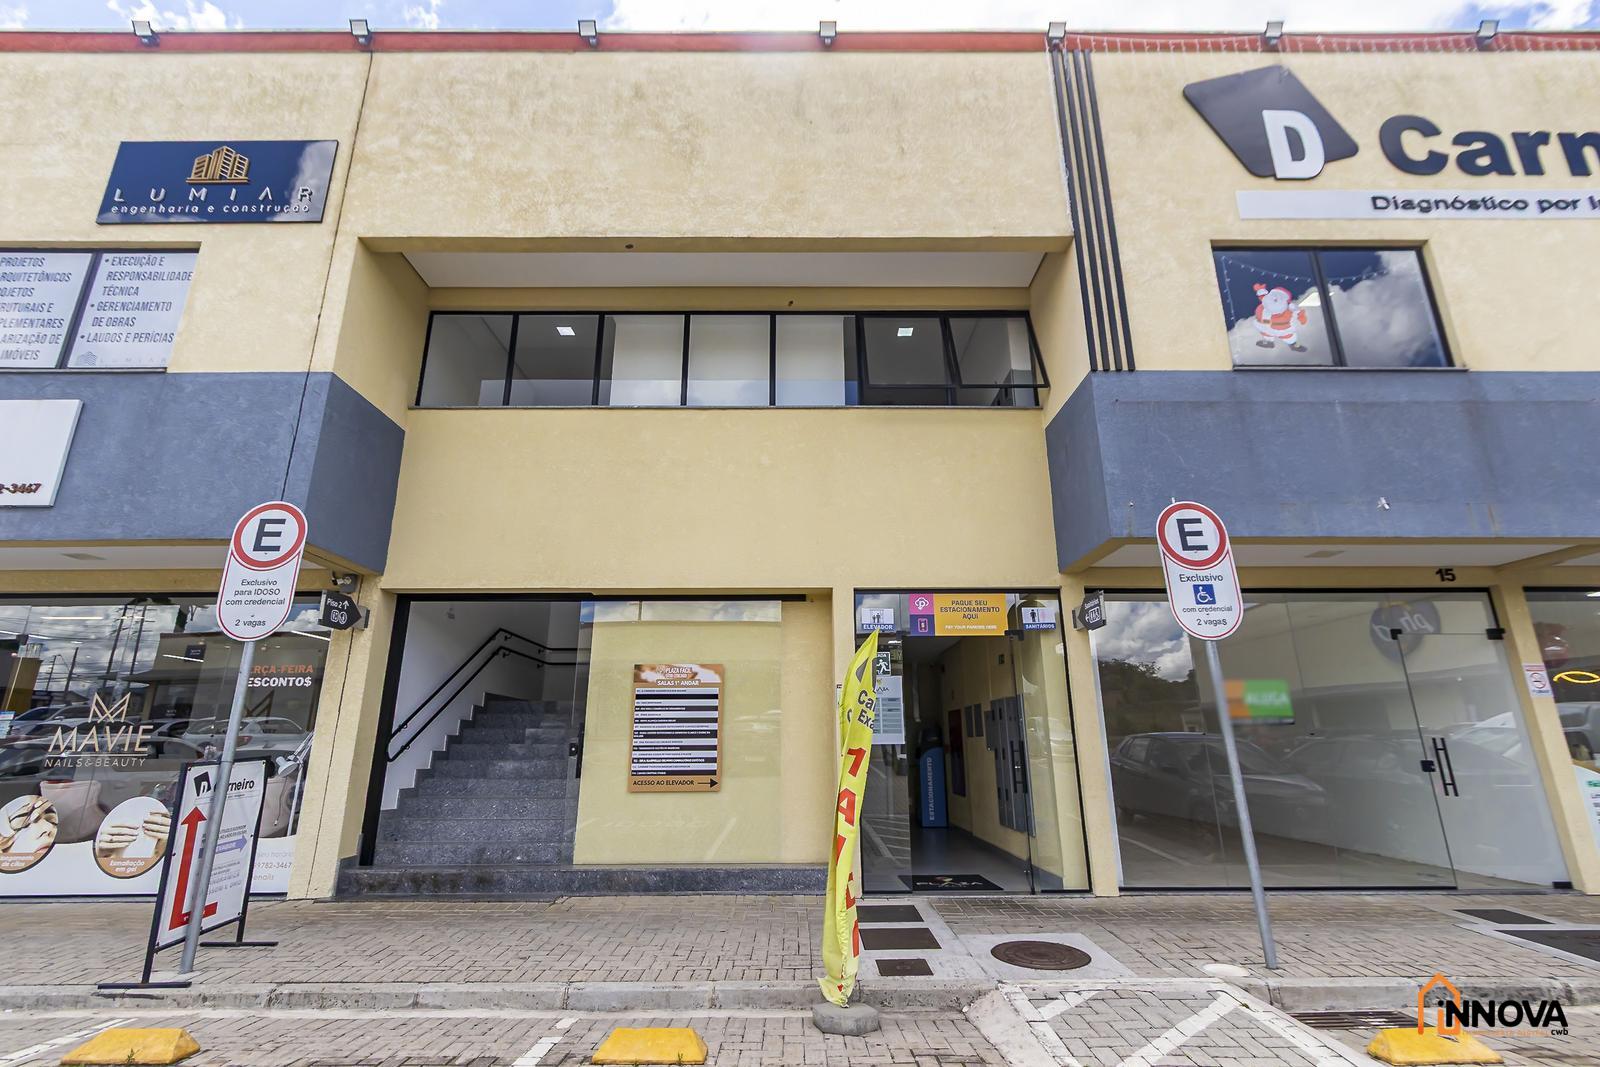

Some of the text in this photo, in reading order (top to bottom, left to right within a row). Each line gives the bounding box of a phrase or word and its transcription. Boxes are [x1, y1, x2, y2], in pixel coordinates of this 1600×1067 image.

[1262, 109, 1326, 179] D
[113, 186, 312, 202] LUMIAR
[111, 204, 199, 215] engenharia
[207, 206, 215, 214] e
[1371, 195, 1529, 213] Diagnóstico
[1538, 199, 1582, 214] por
[111, 254, 166, 267] EXECUÇÃO E
[106, 271, 194, 281] RESPONSABILIDADE
[102, 284, 140, 296] TÉCNICA
[46, 302, 54, 313] E
[96, 301, 173, 312] GERENCIAMENTO
[91, 316, 137, 327] DE OBRAS
[48, 333, 62, 344] DE
[86, 330, 175, 343] LAUDOS E PERÍCIAS
[252, 518, 287, 552] E
[1176, 518, 1208, 551] E
[1179, 573, 1224, 583] Exclusivo
[1435, 568, 1456, 582] 15
[240, 578, 278, 587] Exclusivo
[233, 588, 281, 598] para IDOSO
[244, 597, 286, 606] credencial
[1198, 605, 1233, 613] credencial
[234, 619, 267, 629] 2 vagas
[1196, 618, 1228, 627] 2 vagas
[48, 725, 154, 752] MAVIE
